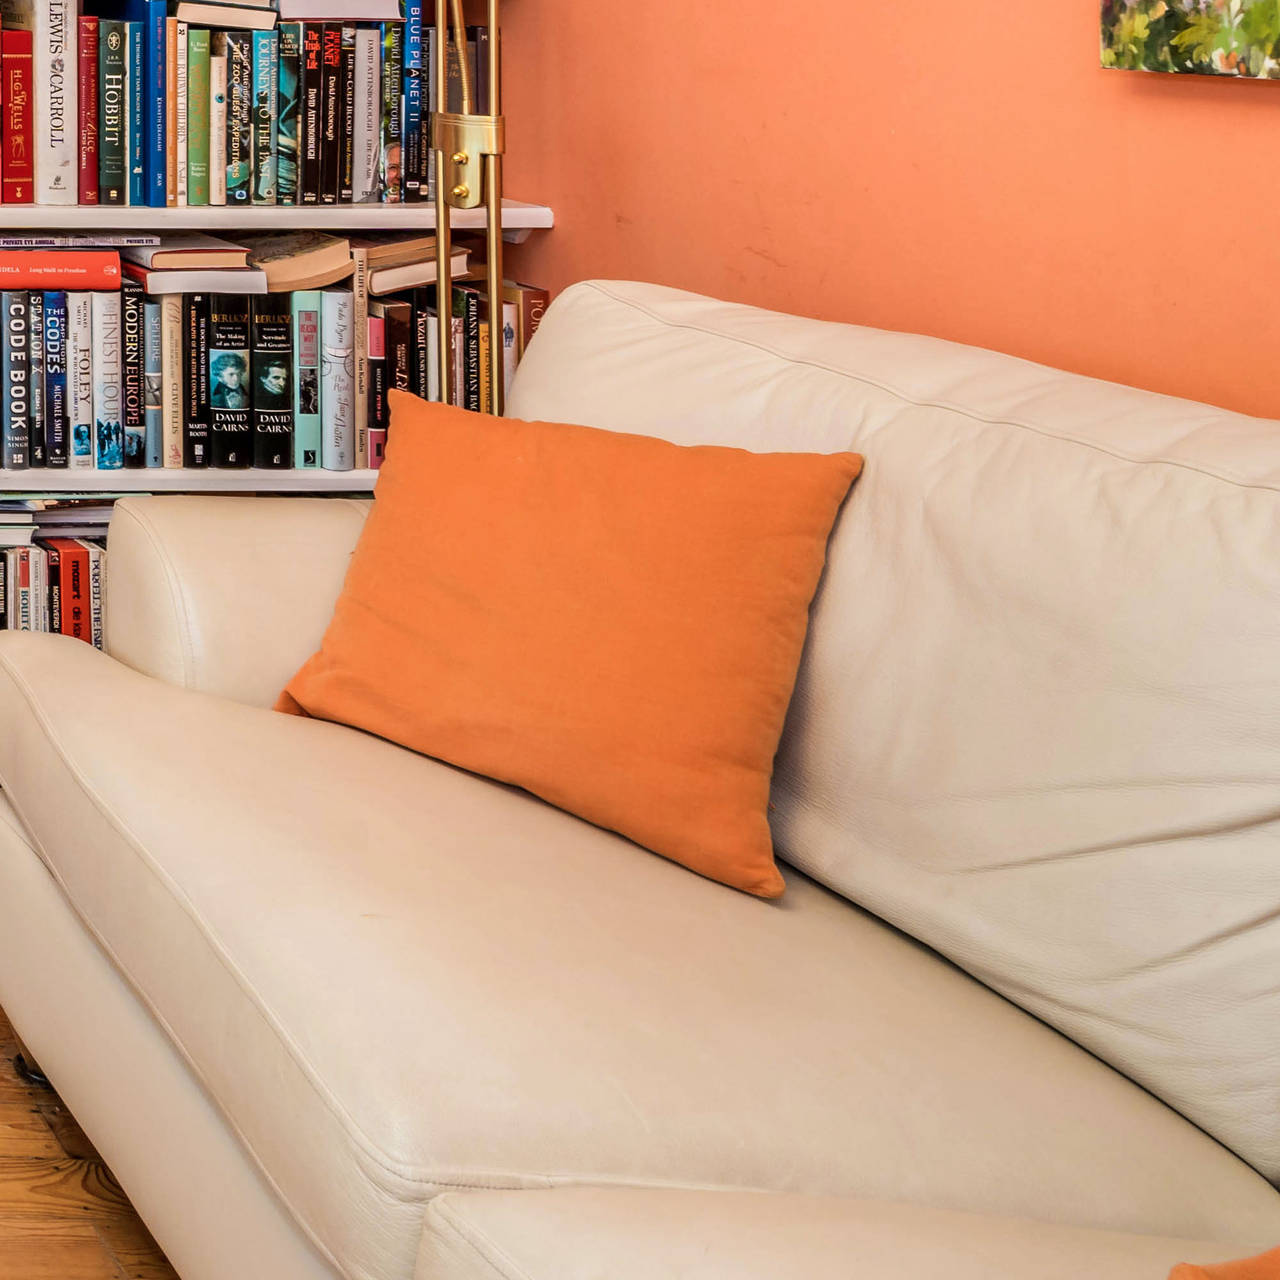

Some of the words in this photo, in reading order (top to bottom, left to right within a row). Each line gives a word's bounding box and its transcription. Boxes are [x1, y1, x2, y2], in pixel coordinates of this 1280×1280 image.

[49, 2, 64, 54] LEWIS
[390, 27, 400, 59] David
[410, 7, 420, 43] BLUE
[388, 62, 400, 138] Attenborough
[410, 51, 420, 107] PLANET
[50, 74, 64, 148] CARROLL
[104, 73, 122, 146] HOBBIT
[410, 113, 419, 122] II
[10, 304, 26, 361] CODE
[32, 296, 42, 358] STATION
[46, 317, 60, 373] CODES
[102, 312, 118, 368] FINEST
[126, 296, 138, 362] MODERN
[32, 365, 42, 375] X
[78, 348, 90, 406] FOLEY
[103, 372, 118, 422] HOUR
[126, 366, 140, 424] EUROPE
[10, 370, 26, 429] BOOK
[216, 413, 247, 422] DAVID
[260, 415, 291, 423] DAVID
[212, 424, 249, 432] CAIRNS
[257, 424, 292, 432] CAIRNS
[72, 561, 81, 599] mozart
